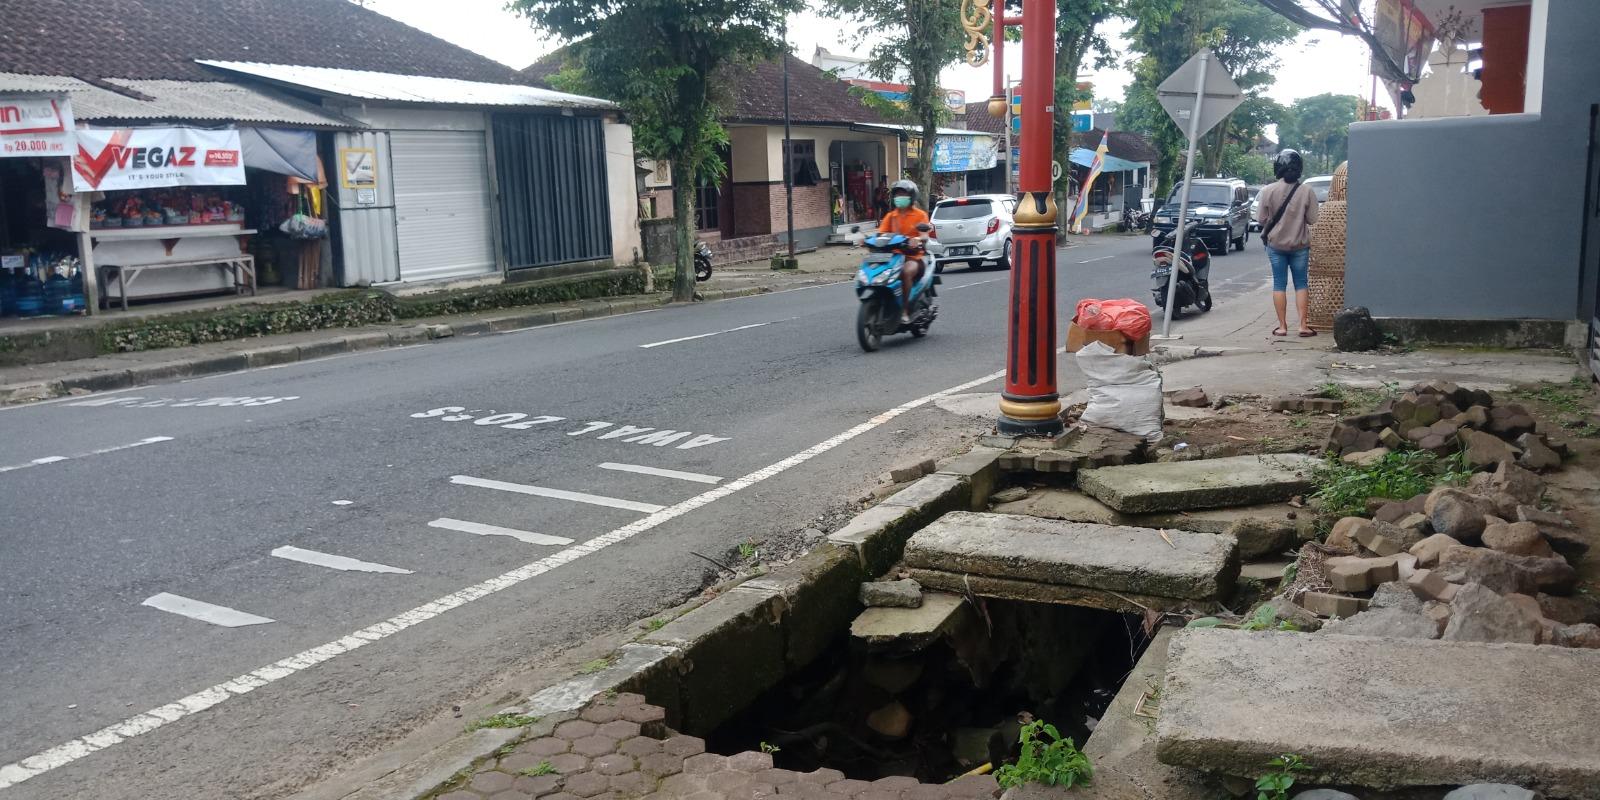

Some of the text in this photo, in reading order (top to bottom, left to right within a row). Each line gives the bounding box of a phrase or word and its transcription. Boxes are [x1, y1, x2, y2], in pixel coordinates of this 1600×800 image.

[15, 140, 47, 152] 20.000
[111, 146, 196, 170] VEGAZ
[567, 421, 733, 450] AWAL
